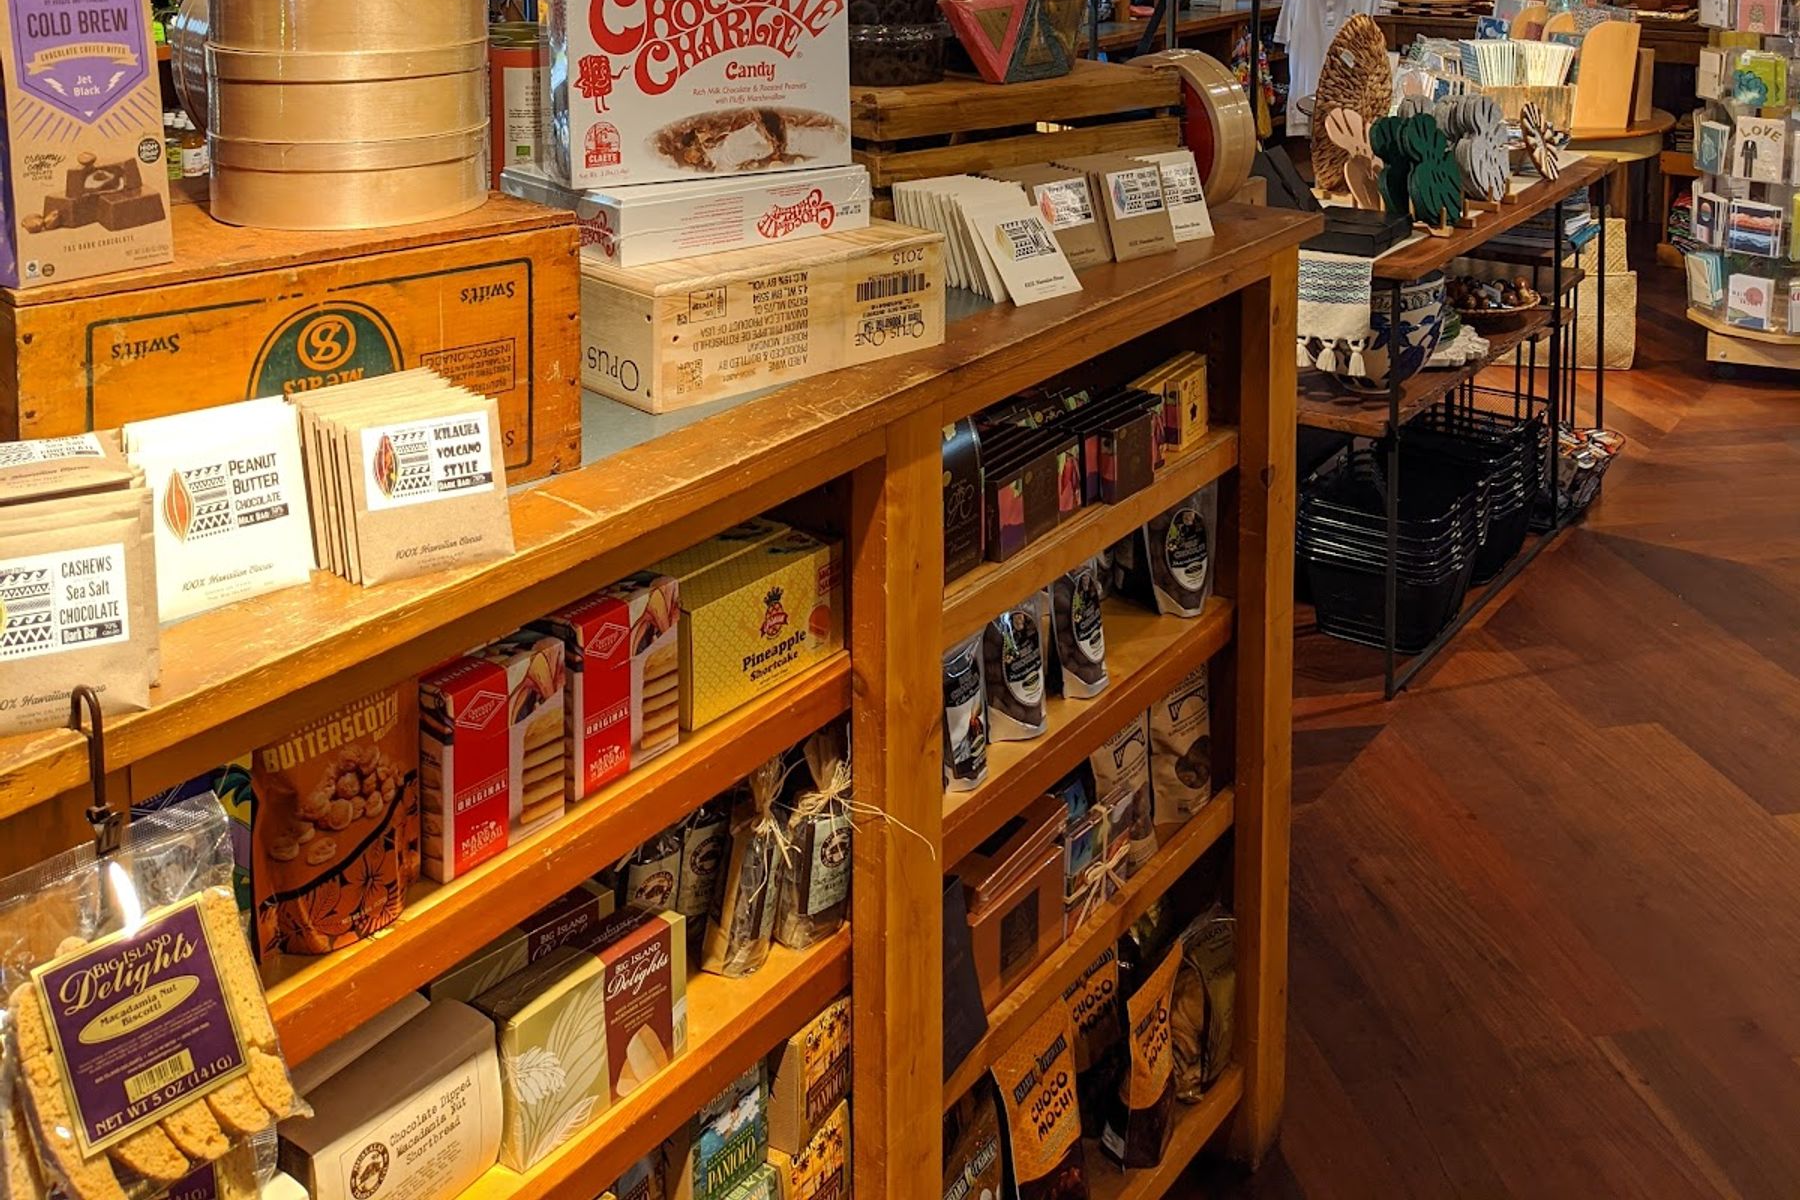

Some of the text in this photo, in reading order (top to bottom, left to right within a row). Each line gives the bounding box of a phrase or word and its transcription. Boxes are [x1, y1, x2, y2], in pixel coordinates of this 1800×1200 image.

[26, 7, 128, 39] COLD BREW
[40, 46, 78, 62] CHOCOLATE
[80, 45, 104, 55] COFFEE
[634, 4, 802, 96] CHARLIE
[77, 75, 93, 85] Jet
[725, 61, 776, 82] Candy
[73, 86, 101, 97] Black
[708, 87, 721, 95] Milk
[722, 85, 751, 94] Chocolate
[747, 93, 786, 102] Marshmallow
[1740, 124, 1783, 143] LOVE
[78, 241, 96, 251] DARK
[97, 234, 135, 248] CHOCOLATE
[893, 247, 924, 266] 2015
[460, 280, 515, 305] Swift's
[700, 326, 715, 338] USA
[716, 324, 728, 335] OF
[729, 316, 763, 332] PRODUCT
[110, 332, 181, 361] Swift's
[693, 335, 740, 352] ROTHSCHILD
[729, 353, 762, 369] BOTTLED
[433, 422, 481, 441] KILAUEA
[436, 441, 482, 460] VOLCANO
[228, 452, 277, 476] PEANUT
[443, 460, 479, 477] STYLE
[232, 472, 280, 495] BUTTER
[235, 491, 282, 511] CHOCOLATE
[420, 540, 458, 555] Hawaiian
[61, 555, 113, 579] CASHEWS
[208, 568, 247, 587] Hawaiian
[66, 578, 111, 601] Sea Salt
[59, 600, 120, 625] CHOCOLATE
[62, 623, 99, 644] Dark Bar
[742, 629, 807, 673] Pineapple
[750, 651, 798, 682] Shortcake
[263, 691, 400, 773] BUTTERSCOTCH
[586, 709, 630, 736] ORIGINAL
[589, 751, 615, 773] MADE
[456, 779, 507, 812] ORIGINAL
[461, 826, 492, 852] MADE
[556, 913, 588, 937] ISLAND
[93, 933, 173, 980] BIG ISLAND
[615, 941, 662, 975] BIG ISLAND
[58, 932, 199, 1017] Delights
[606, 949, 669, 1002] Delights
[100, 982, 179, 1029] Macadamia Nut
[1072, 978, 1114, 1023] CHOCO
[121, 1000, 163, 1028] Biscotti
[95, 1111, 124, 1137] NET
[126, 1099, 149, 1123] WT
[151, 1090, 163, 1107] 5
[164, 1079, 187, 1099] OZ
[1030, 1070, 1068, 1125] CHOCO
[389, 1075, 472, 1148] Chocolate Dipped
[1037, 1088, 1074, 1143] MOCHI
[396, 1096, 467, 1159] Macadamia Nut
[405, 1114, 461, 1166] Shortbread
[707, 1135, 756, 1195] PANIOLO
